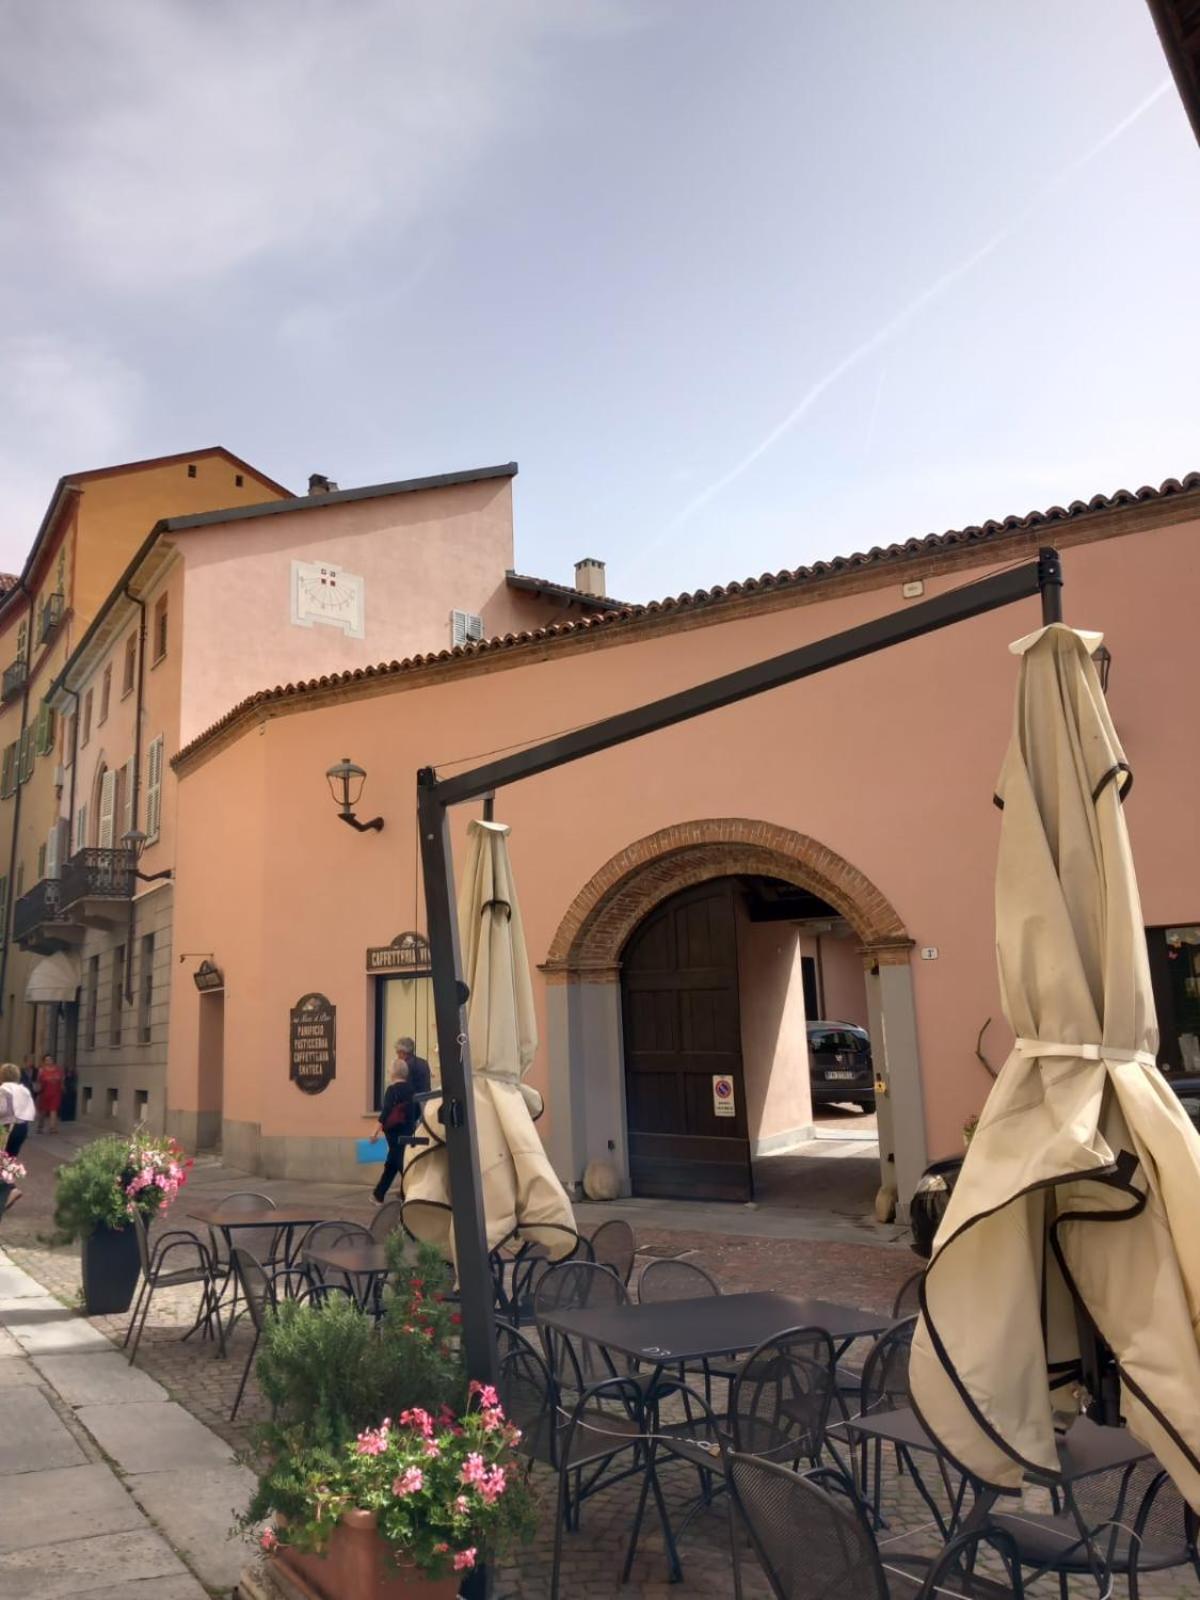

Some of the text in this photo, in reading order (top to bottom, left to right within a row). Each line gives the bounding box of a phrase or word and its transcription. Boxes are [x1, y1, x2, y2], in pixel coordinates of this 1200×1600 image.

[371, 948, 416, 967] CAFFETTERIA
[298, 1025, 325, 1037] PANIFICIO
[294, 1038, 328, 1050] PASTICCERIA
[294, 1050, 329, 1063] CAFFETTERIA
